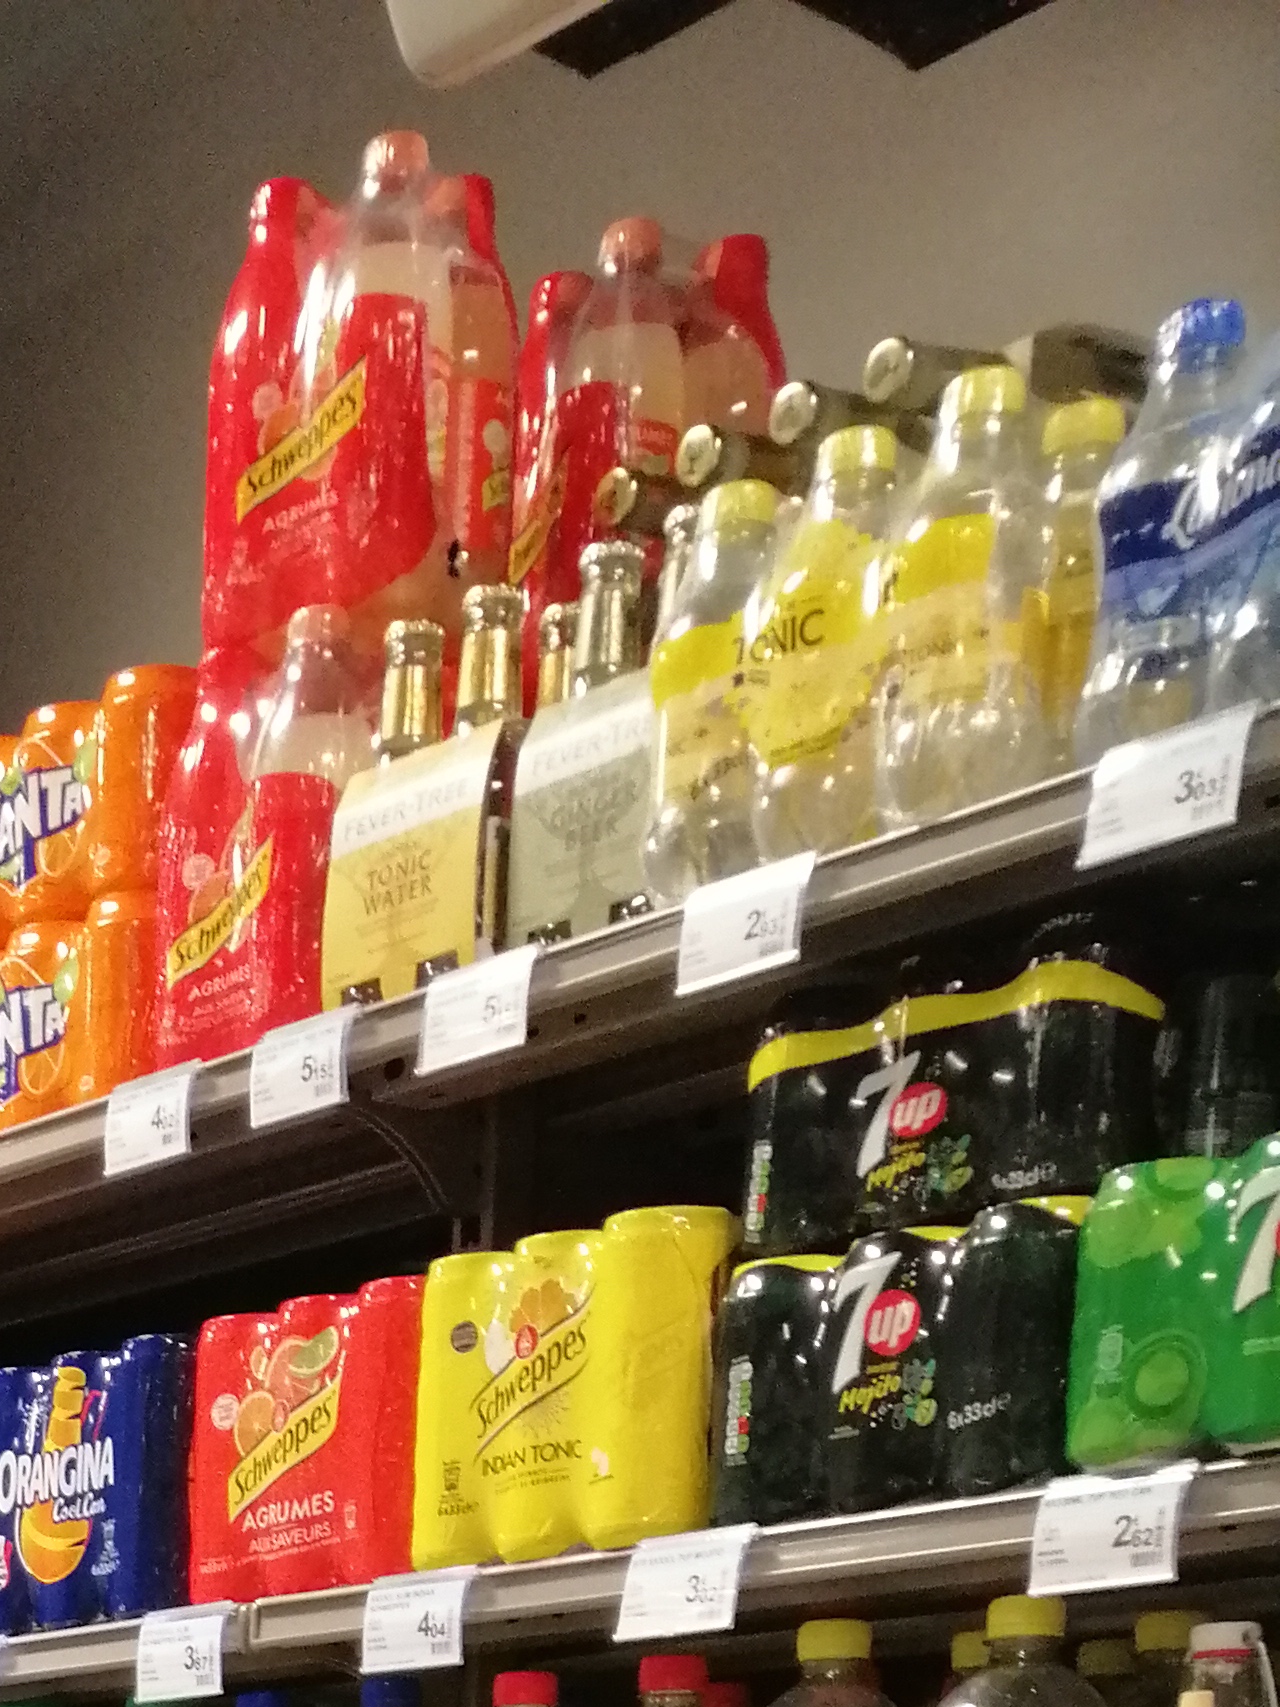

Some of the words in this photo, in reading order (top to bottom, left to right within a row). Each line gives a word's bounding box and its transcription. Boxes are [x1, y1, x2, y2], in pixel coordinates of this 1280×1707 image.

[246, 392, 358, 493] Schweppes
[368, 850, 431, 891] TONIC
[362, 881, 432, 916] WATER
[894, 1088, 942, 1128] up
[867, 1297, 913, 1347] up
[476, 1321, 588, 1436] Schweppes
[233, 1400, 332, 1505] Schweppes
[532, 1439, 582, 1464] TONIC
[242, 1491, 335, 1532] AGRUMES
